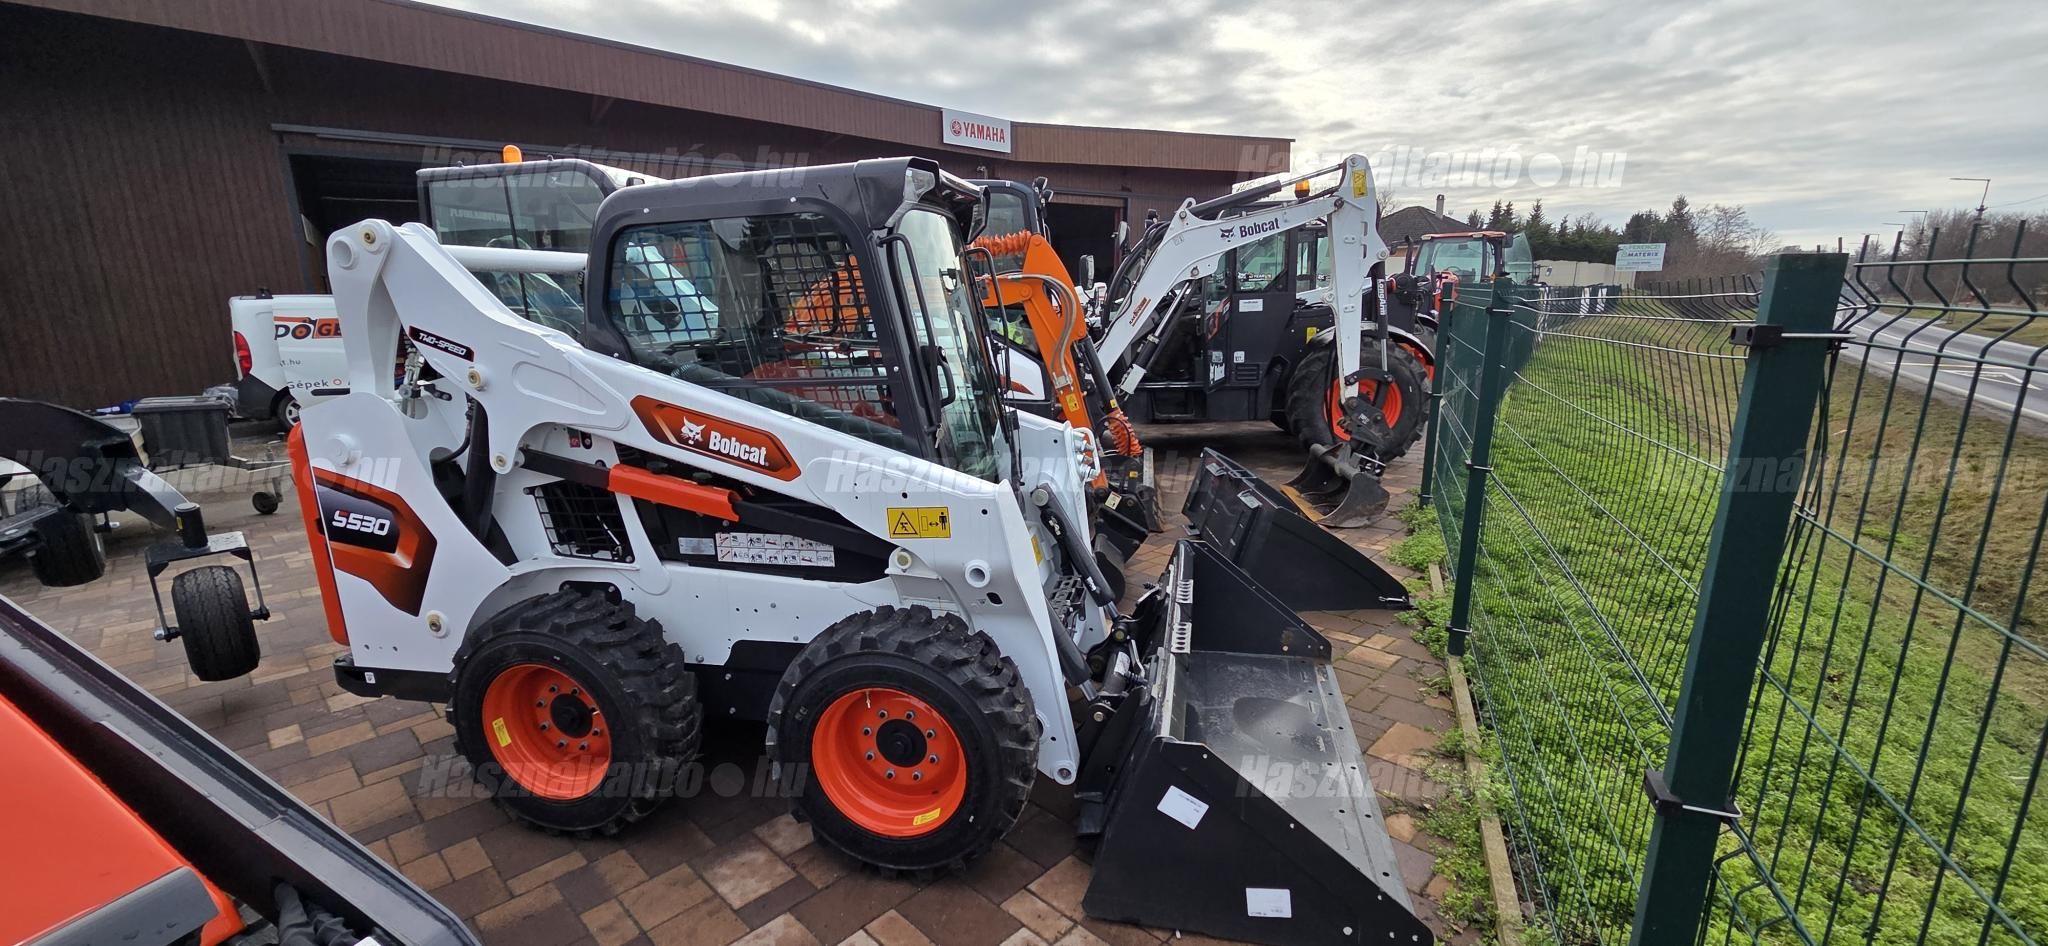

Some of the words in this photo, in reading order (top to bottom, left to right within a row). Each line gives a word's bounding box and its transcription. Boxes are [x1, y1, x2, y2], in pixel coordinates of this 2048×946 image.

[963, 122, 1005, 143] YAMAHA
[1239, 218, 1280, 238] Bobcat
[419, 333, 467, 356] TWO-SPEED
[709, 431, 767, 465] Bobcat
[332, 510, 391, 536] S530
